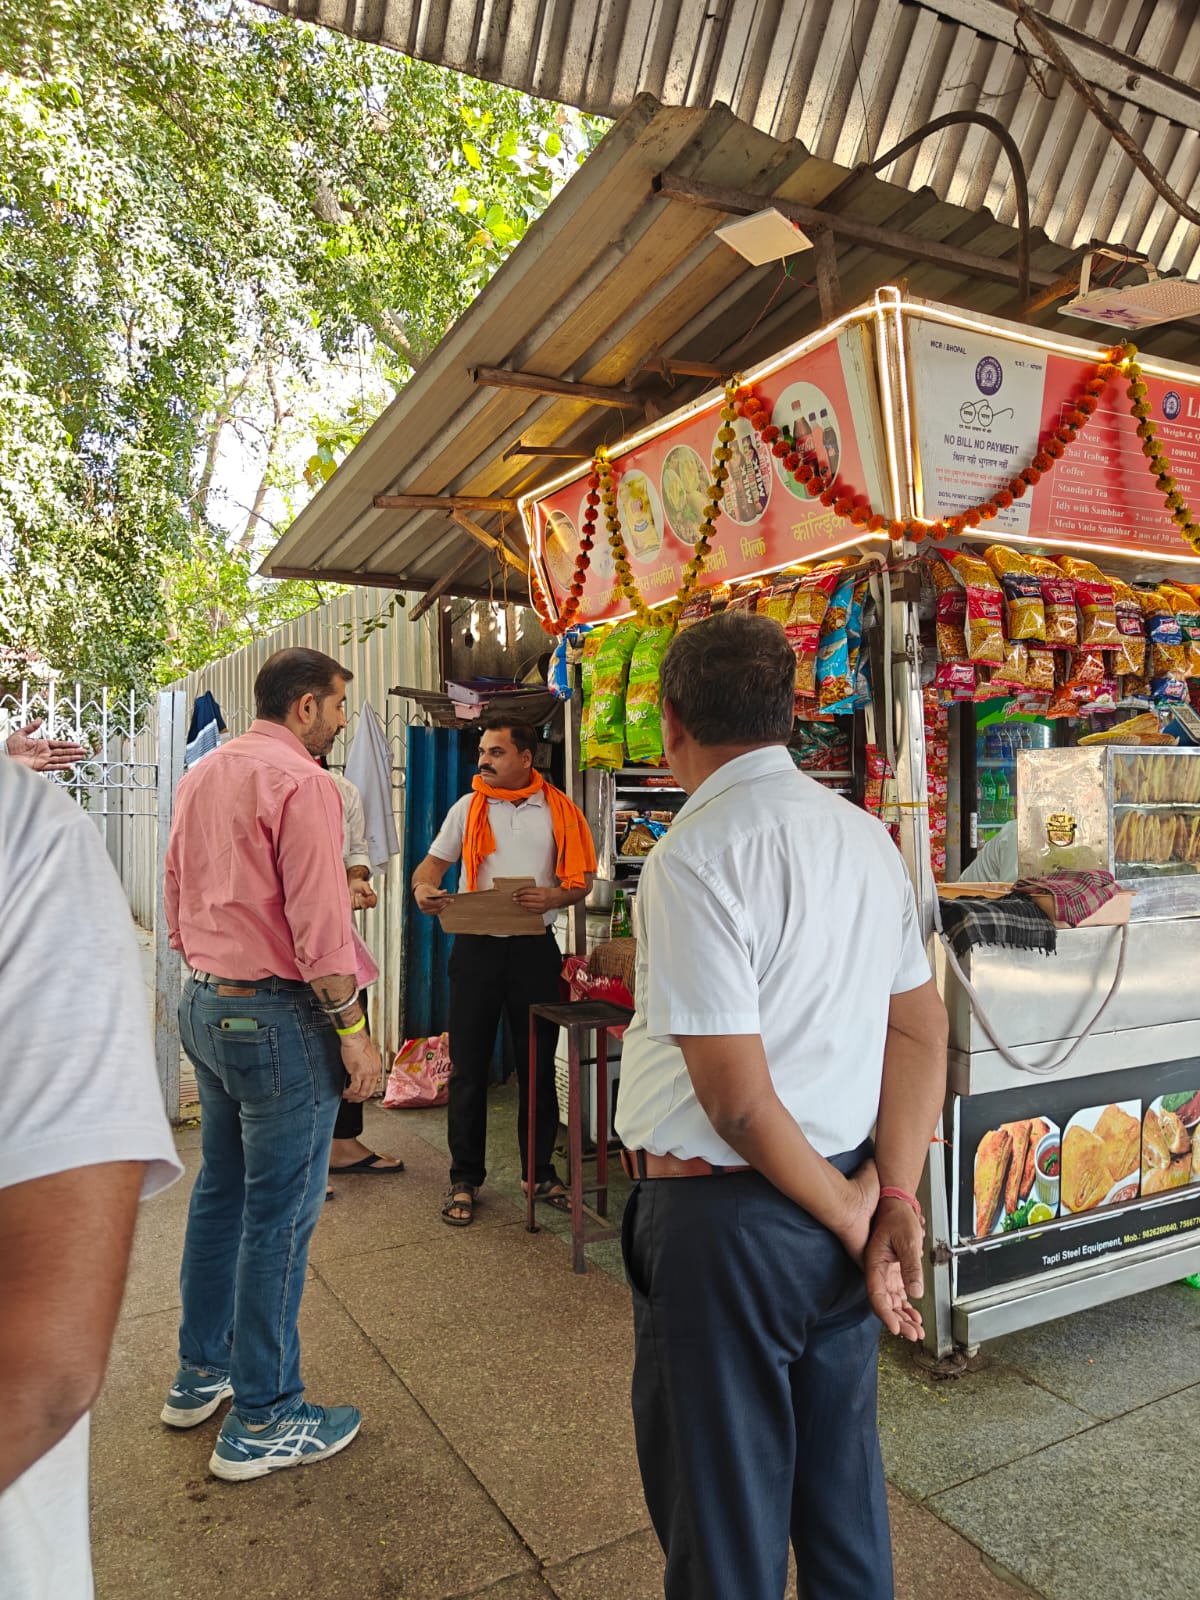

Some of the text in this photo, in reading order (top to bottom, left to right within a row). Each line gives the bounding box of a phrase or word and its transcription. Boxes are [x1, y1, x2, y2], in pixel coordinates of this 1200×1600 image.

[946, 343, 967, 355] BHOPAL
[1163, 427, 1185, 438] Weight
[944, 434, 1019, 455] NO BILL NO PAYMENT
[978, 457, 998, 469] भुगतान
[1060, 465, 1085, 477] Coffee
[1057, 482, 1108, 498] Standard Tea
[1055, 501, 1071, 513] Idly
[1073, 503, 1090, 513] with
[1091, 505, 1125, 518] Sambhar
[1077, 521, 1097, 533] Vada
[1097, 523, 1132, 536] Sambhar
[739, 535, 766, 561] मिल्क
[1042, 1254, 1061, 1266] Tapti
[1062, 1246, 1081, 1260] Steel
[1082, 1236, 1122, 1255] Equipment,
